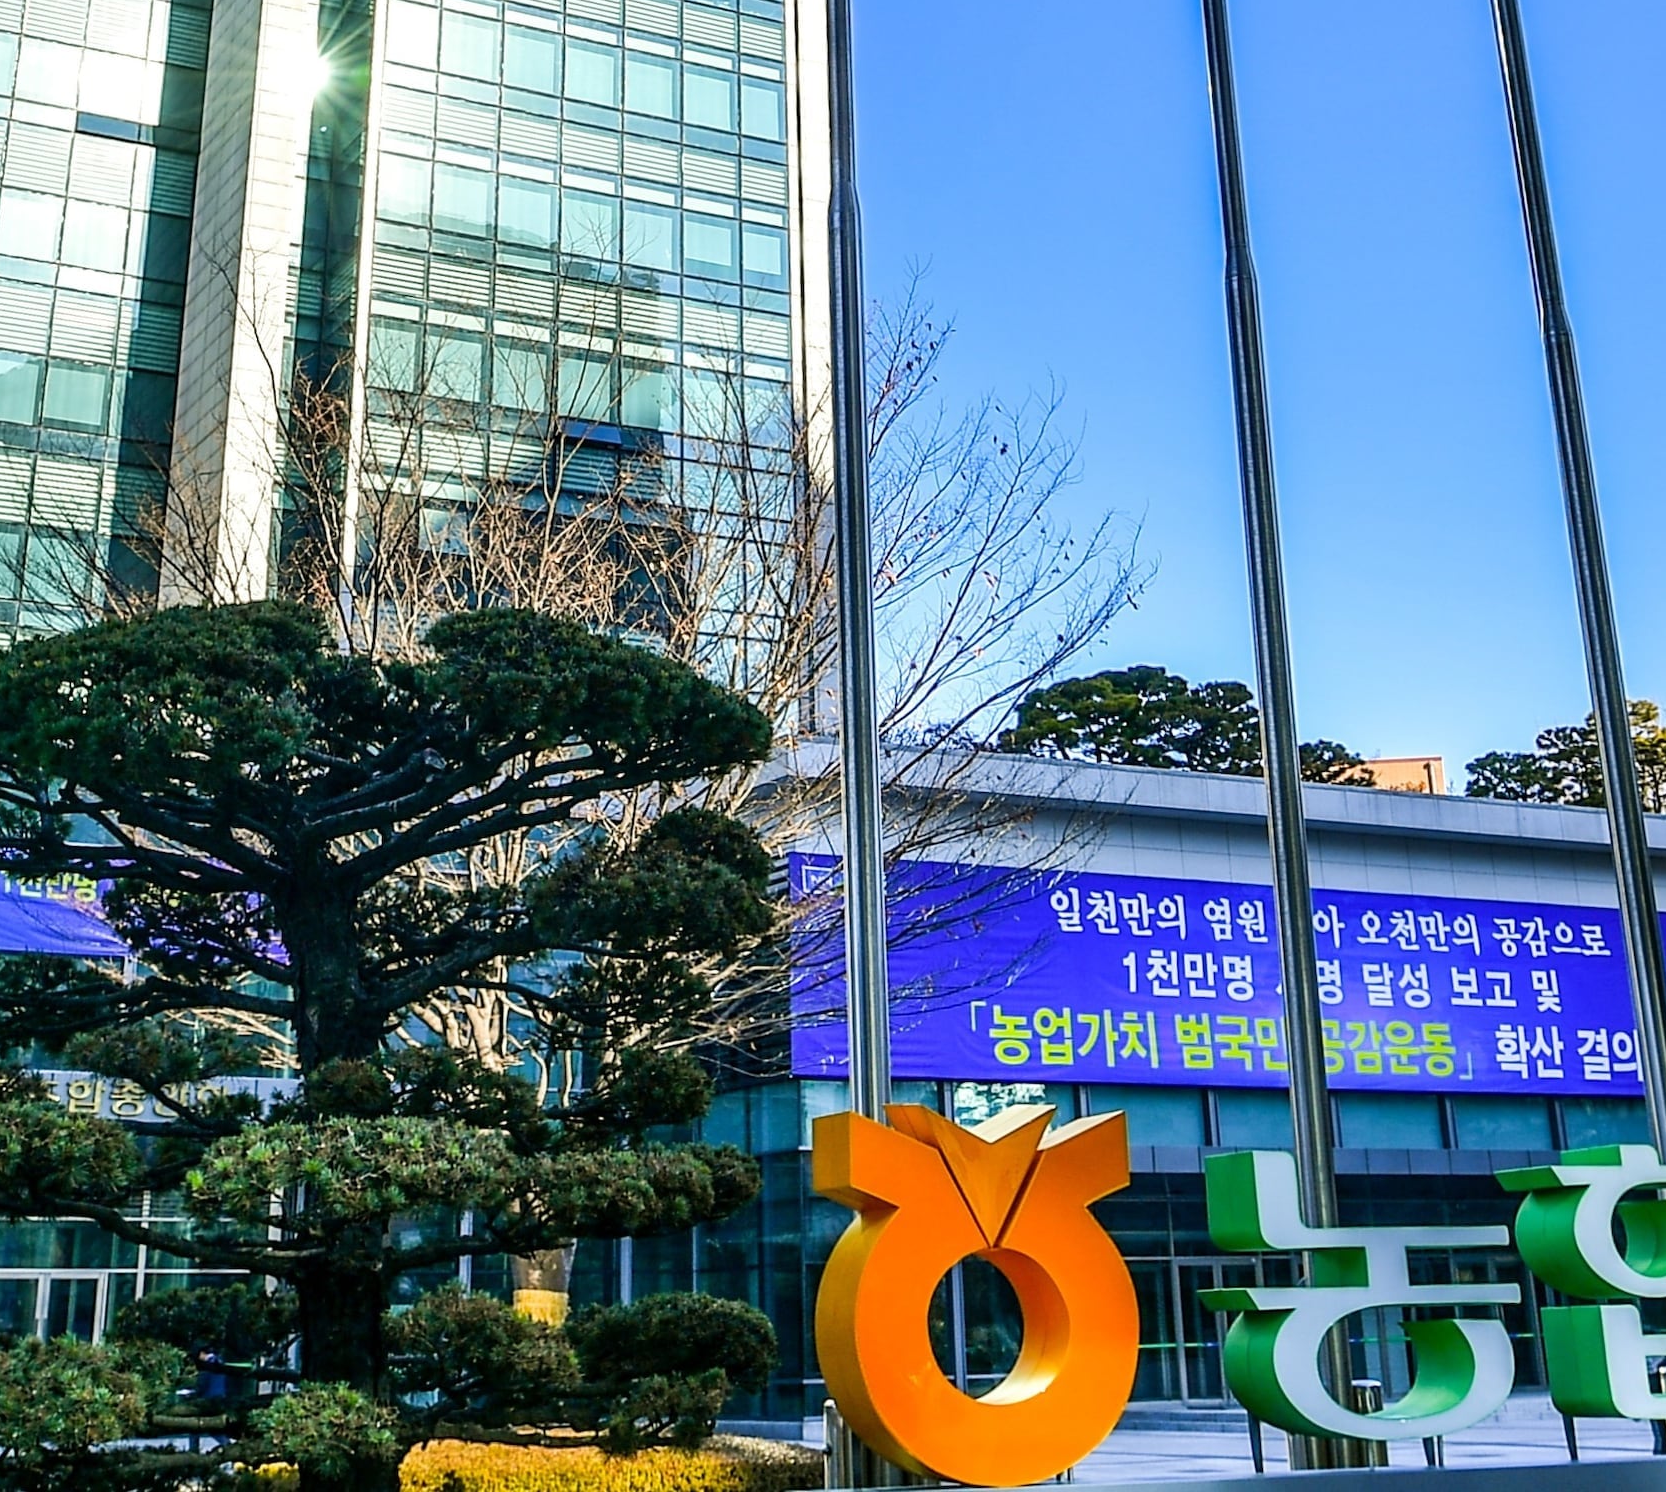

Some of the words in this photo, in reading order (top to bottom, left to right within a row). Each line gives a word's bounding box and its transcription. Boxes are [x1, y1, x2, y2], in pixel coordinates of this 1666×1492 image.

[1050, 887, 1186, 941] 일천만의
[1202, 896, 1269, 943] 염원
[1311, 904, 1346, 949] 아
[1356, 909, 1482, 957] 오천만의
[1492, 917, 1611, 958] 공감으로
[1121, 949, 1255, 1002] 1천만명
[1361, 962, 1432, 1008] 달성
[1451, 966, 1517, 1008] 보고
[1531, 969, 1563, 1013] 및
[1494, 1023, 1565, 1080] 확산
